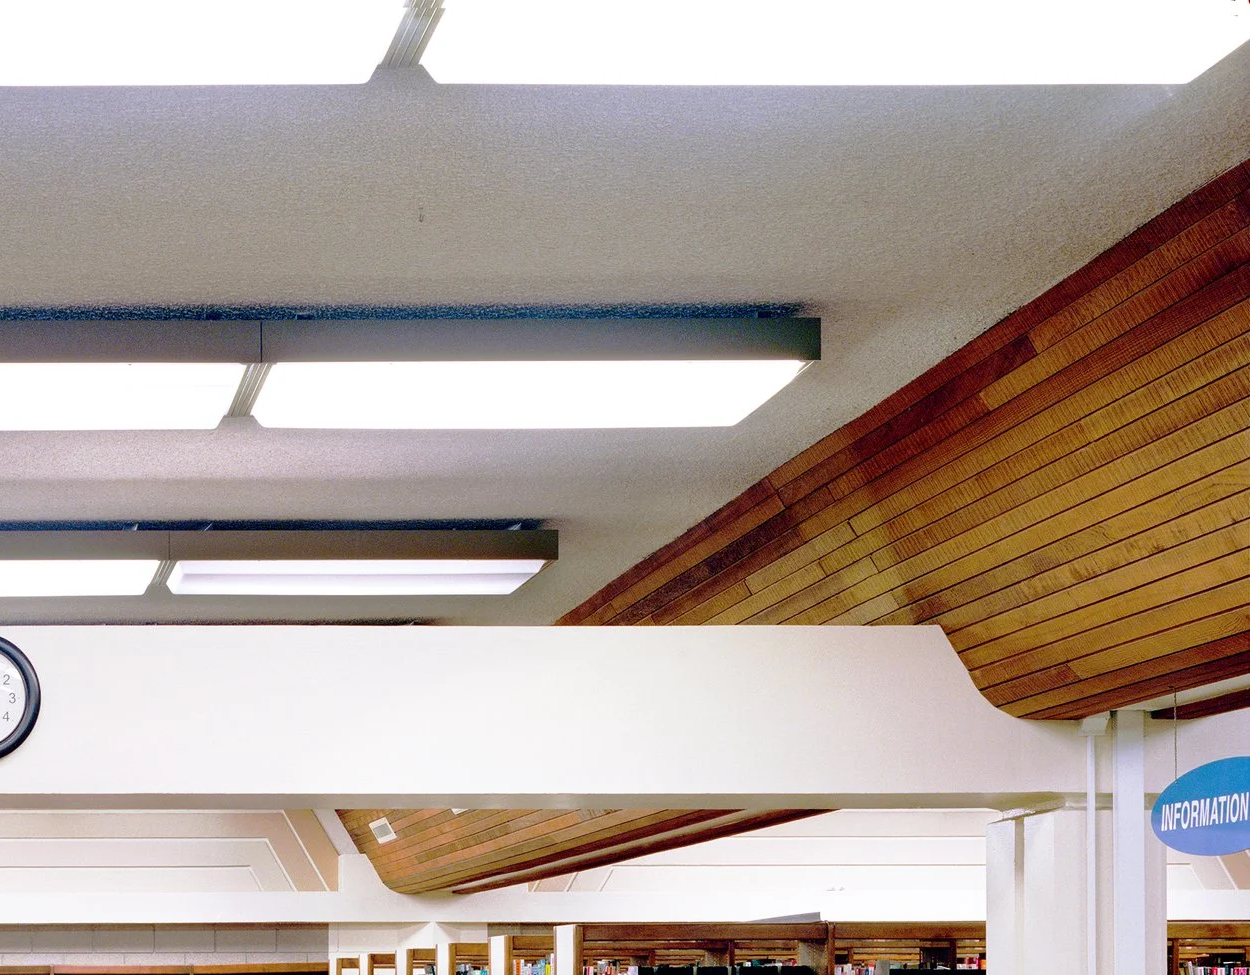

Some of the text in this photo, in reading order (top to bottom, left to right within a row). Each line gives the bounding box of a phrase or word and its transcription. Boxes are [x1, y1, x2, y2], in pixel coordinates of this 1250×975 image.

[3, 674, 11, 686] 2
[9, 692, 16, 704] 3
[2, 711, 10, 722] 4
[1160, 791, 1250, 832] INFORMATION
